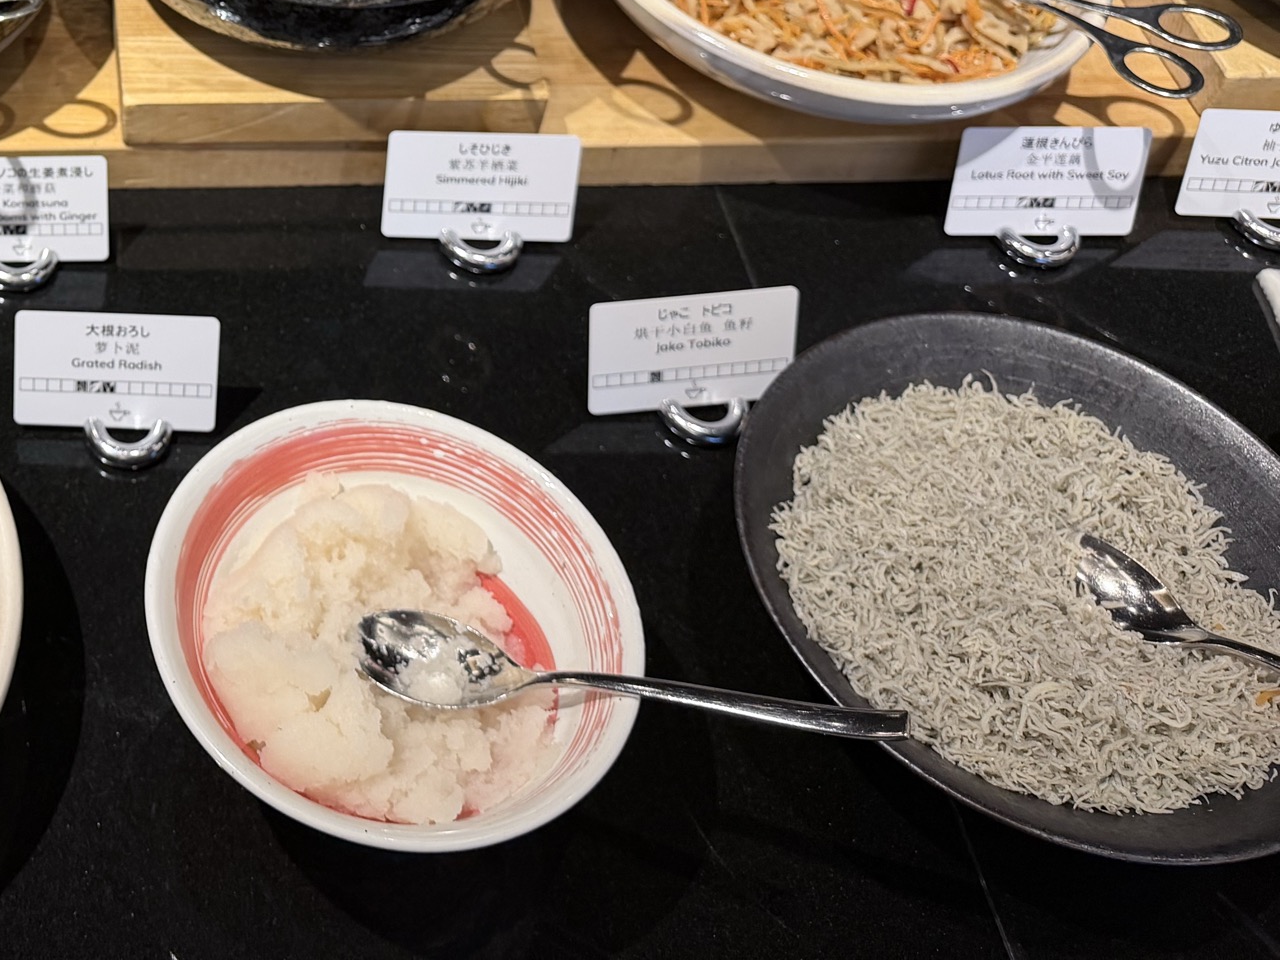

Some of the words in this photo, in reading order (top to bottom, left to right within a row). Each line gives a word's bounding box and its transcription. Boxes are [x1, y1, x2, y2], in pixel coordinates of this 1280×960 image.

[1021, 135, 1094, 149] 蓮根きんぴら
[458, 143, 512, 156] しそひじき
[1200, 154, 1229, 165] Yuzu
[1232, 156, 1268, 167] Citron
[436, 174, 496, 186] Simmered
[498, 175, 528, 187] Hijiki
[971, 169, 1003, 180] Lotus
[1006, 169, 1034, 180] Root
[1038, 169, 1064, 180] with
[1066, 169, 1104, 180] Sweet
[1106, 169, 1130, 182] Soy
[2, 198, 68, 208] Komatsuna
[31, 211, 57, 221] with
[59, 211, 98, 223] Ginger
[657, 306, 690, 321] じゃこ
[85, 323, 151, 338] 大根おろし
[95, 341, 141, 356] 萝卜泥
[656, 341, 684, 354] Jako
[689, 337, 732, 349] Tobiko
[71, 357, 115, 369] Grated
[118, 359, 163, 371] Radish
